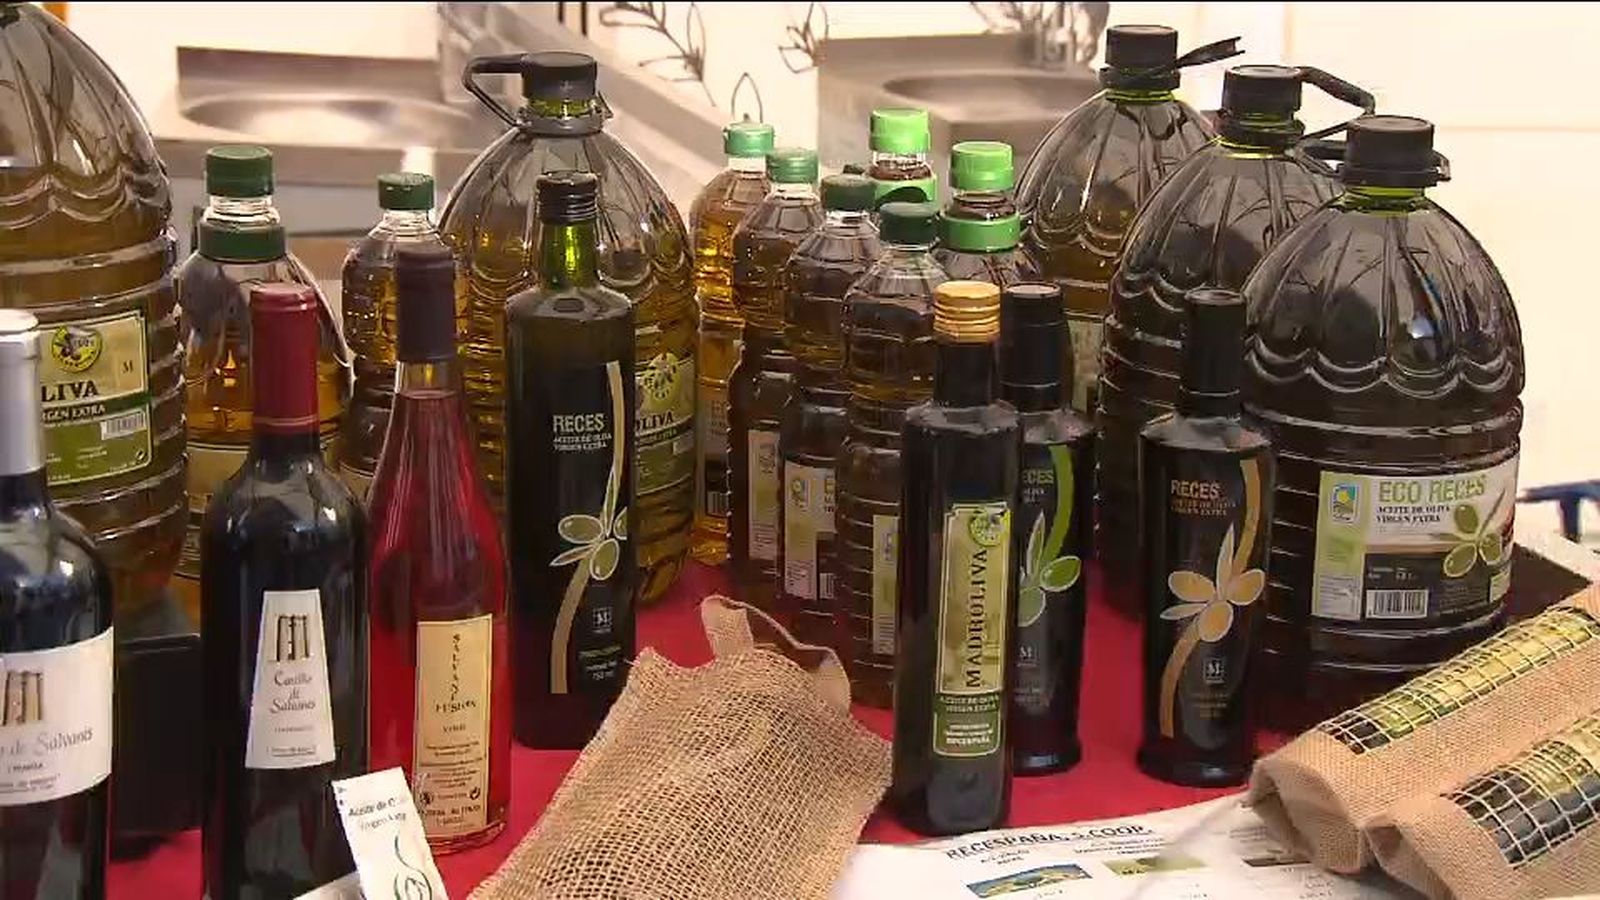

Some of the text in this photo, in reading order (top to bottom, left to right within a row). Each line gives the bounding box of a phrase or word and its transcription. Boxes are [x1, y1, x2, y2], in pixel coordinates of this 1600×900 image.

[40, 379, 100, 402] LIVA
[72, 404, 106, 418] EXTRA
[552, 413, 605, 433] RECES
[1170, 479, 1222, 501] RECES
[1379, 478, 1485, 504] ECO RECES
[1375, 514, 1410, 524] VIRGEN
[1377, 505, 1409, 515] ACEITE
[1425, 504, 1451, 515] OLIVA
[965, 550, 988, 688] MADROLIVA
